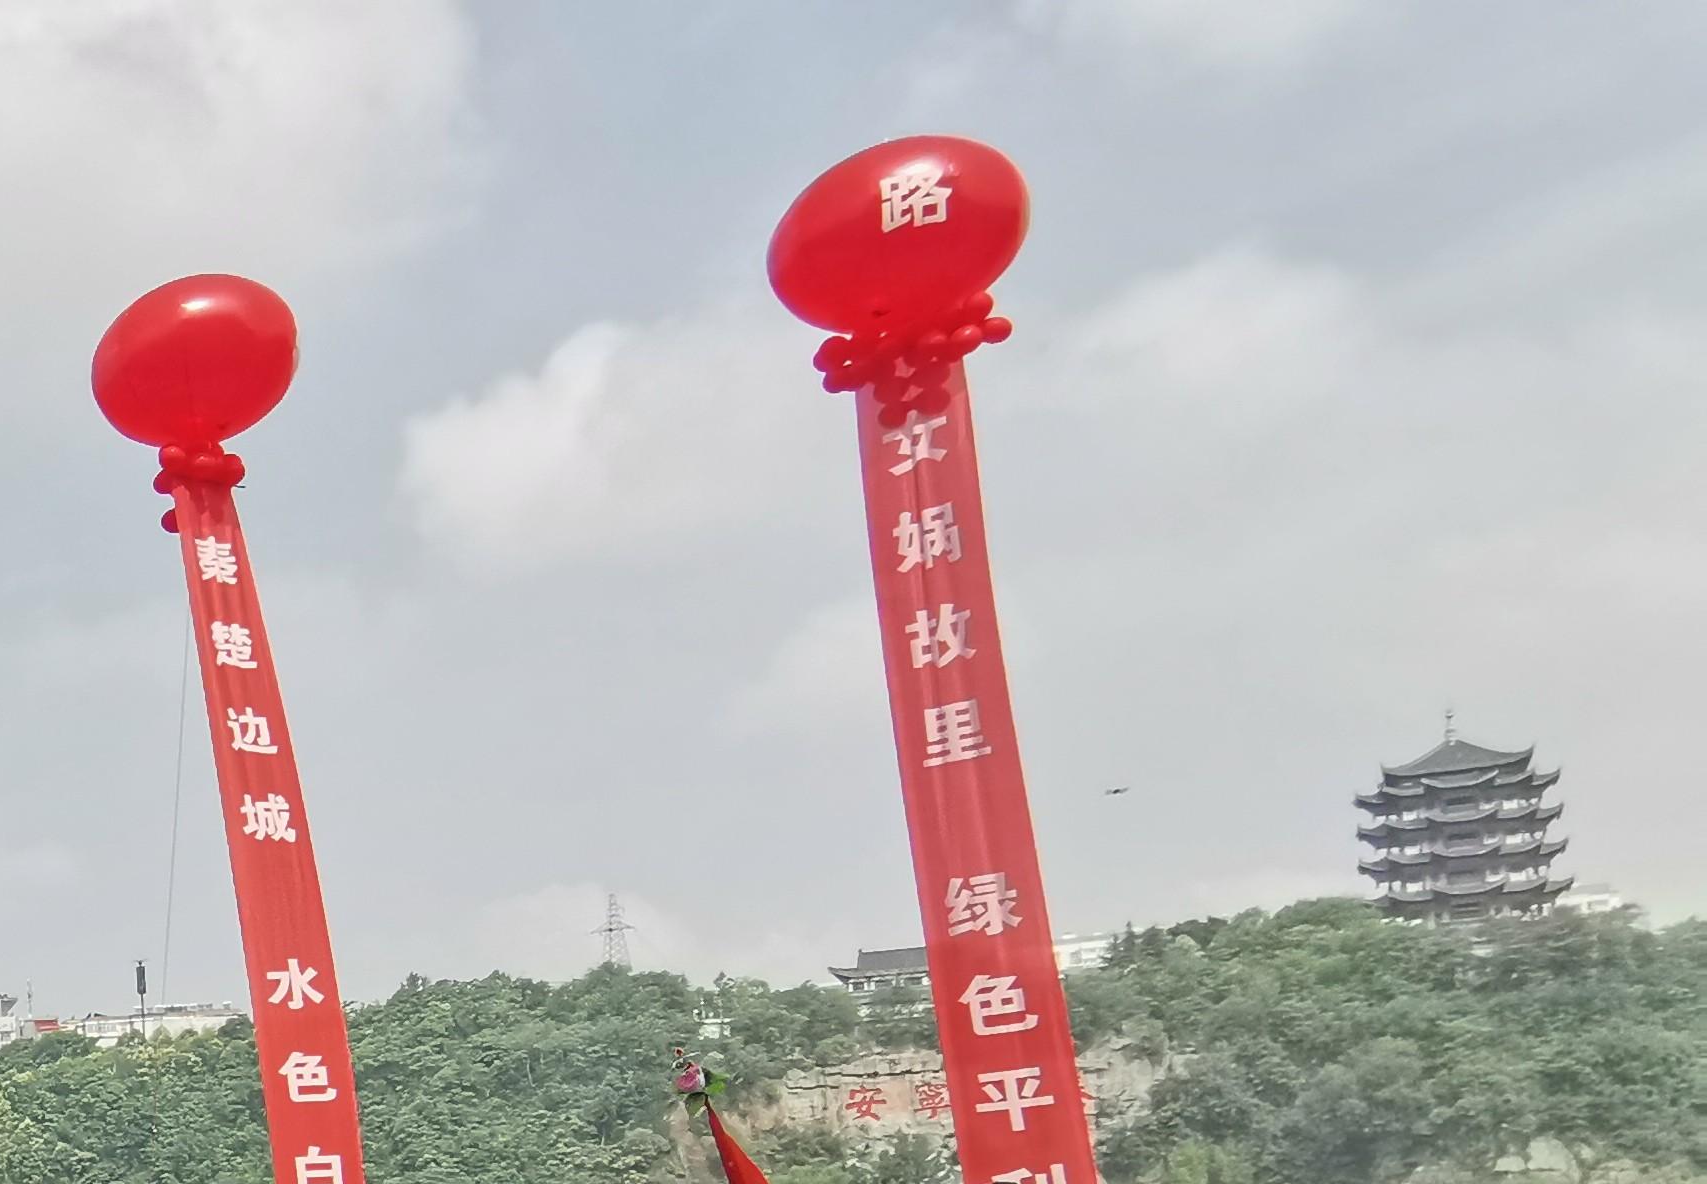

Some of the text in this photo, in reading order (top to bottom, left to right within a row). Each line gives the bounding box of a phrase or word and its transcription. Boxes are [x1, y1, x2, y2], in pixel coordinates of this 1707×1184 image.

[879, 166, 953, 234] 路
[194, 535, 297, 843] 秦楚边城
[883, 409, 992, 768] 女娲故里
